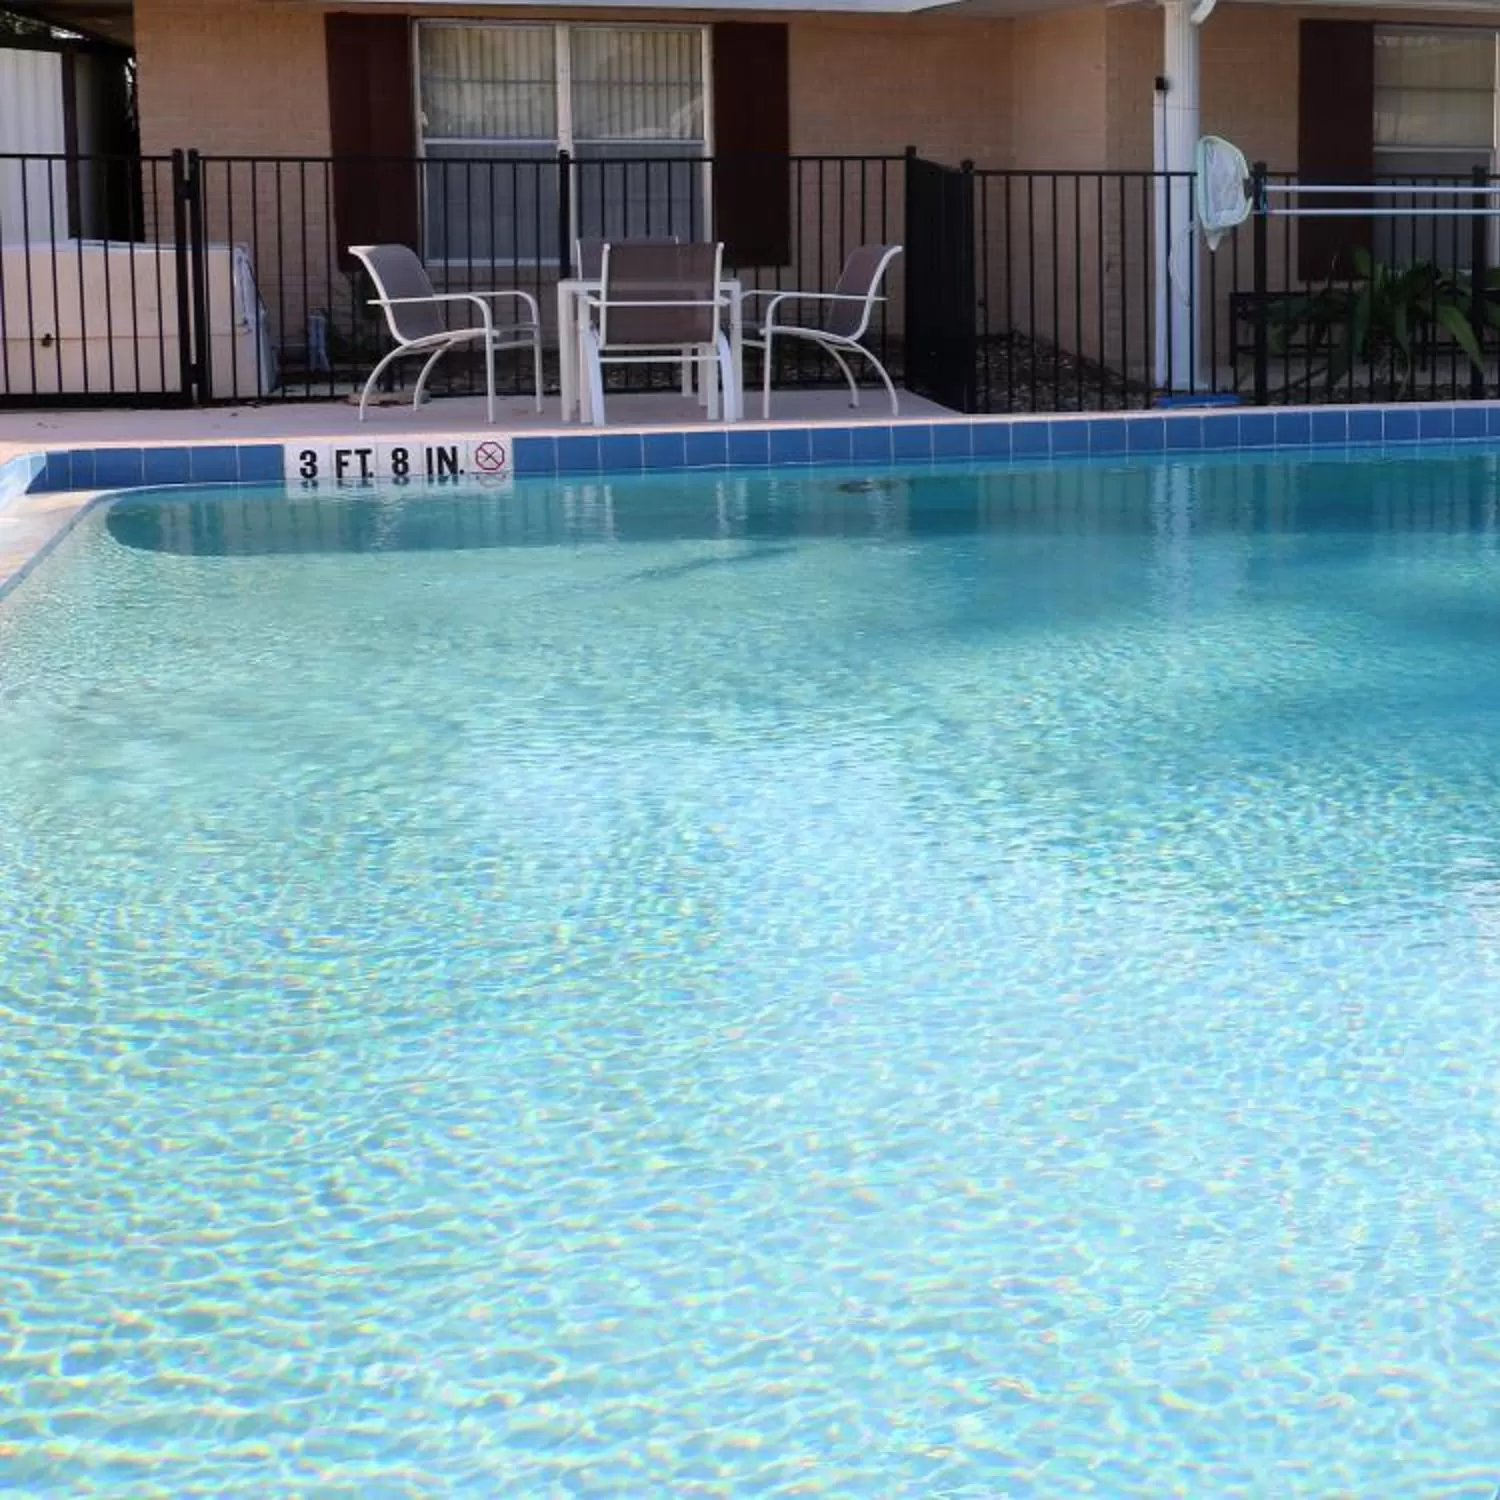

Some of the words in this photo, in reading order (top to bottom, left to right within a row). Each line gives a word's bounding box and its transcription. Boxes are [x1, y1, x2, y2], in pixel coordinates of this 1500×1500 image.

[299, 449, 318, 480] 3
[335, 448, 374, 479] FT.
[391, 447, 409, 476] 8
[426, 446, 464, 475] IN.
